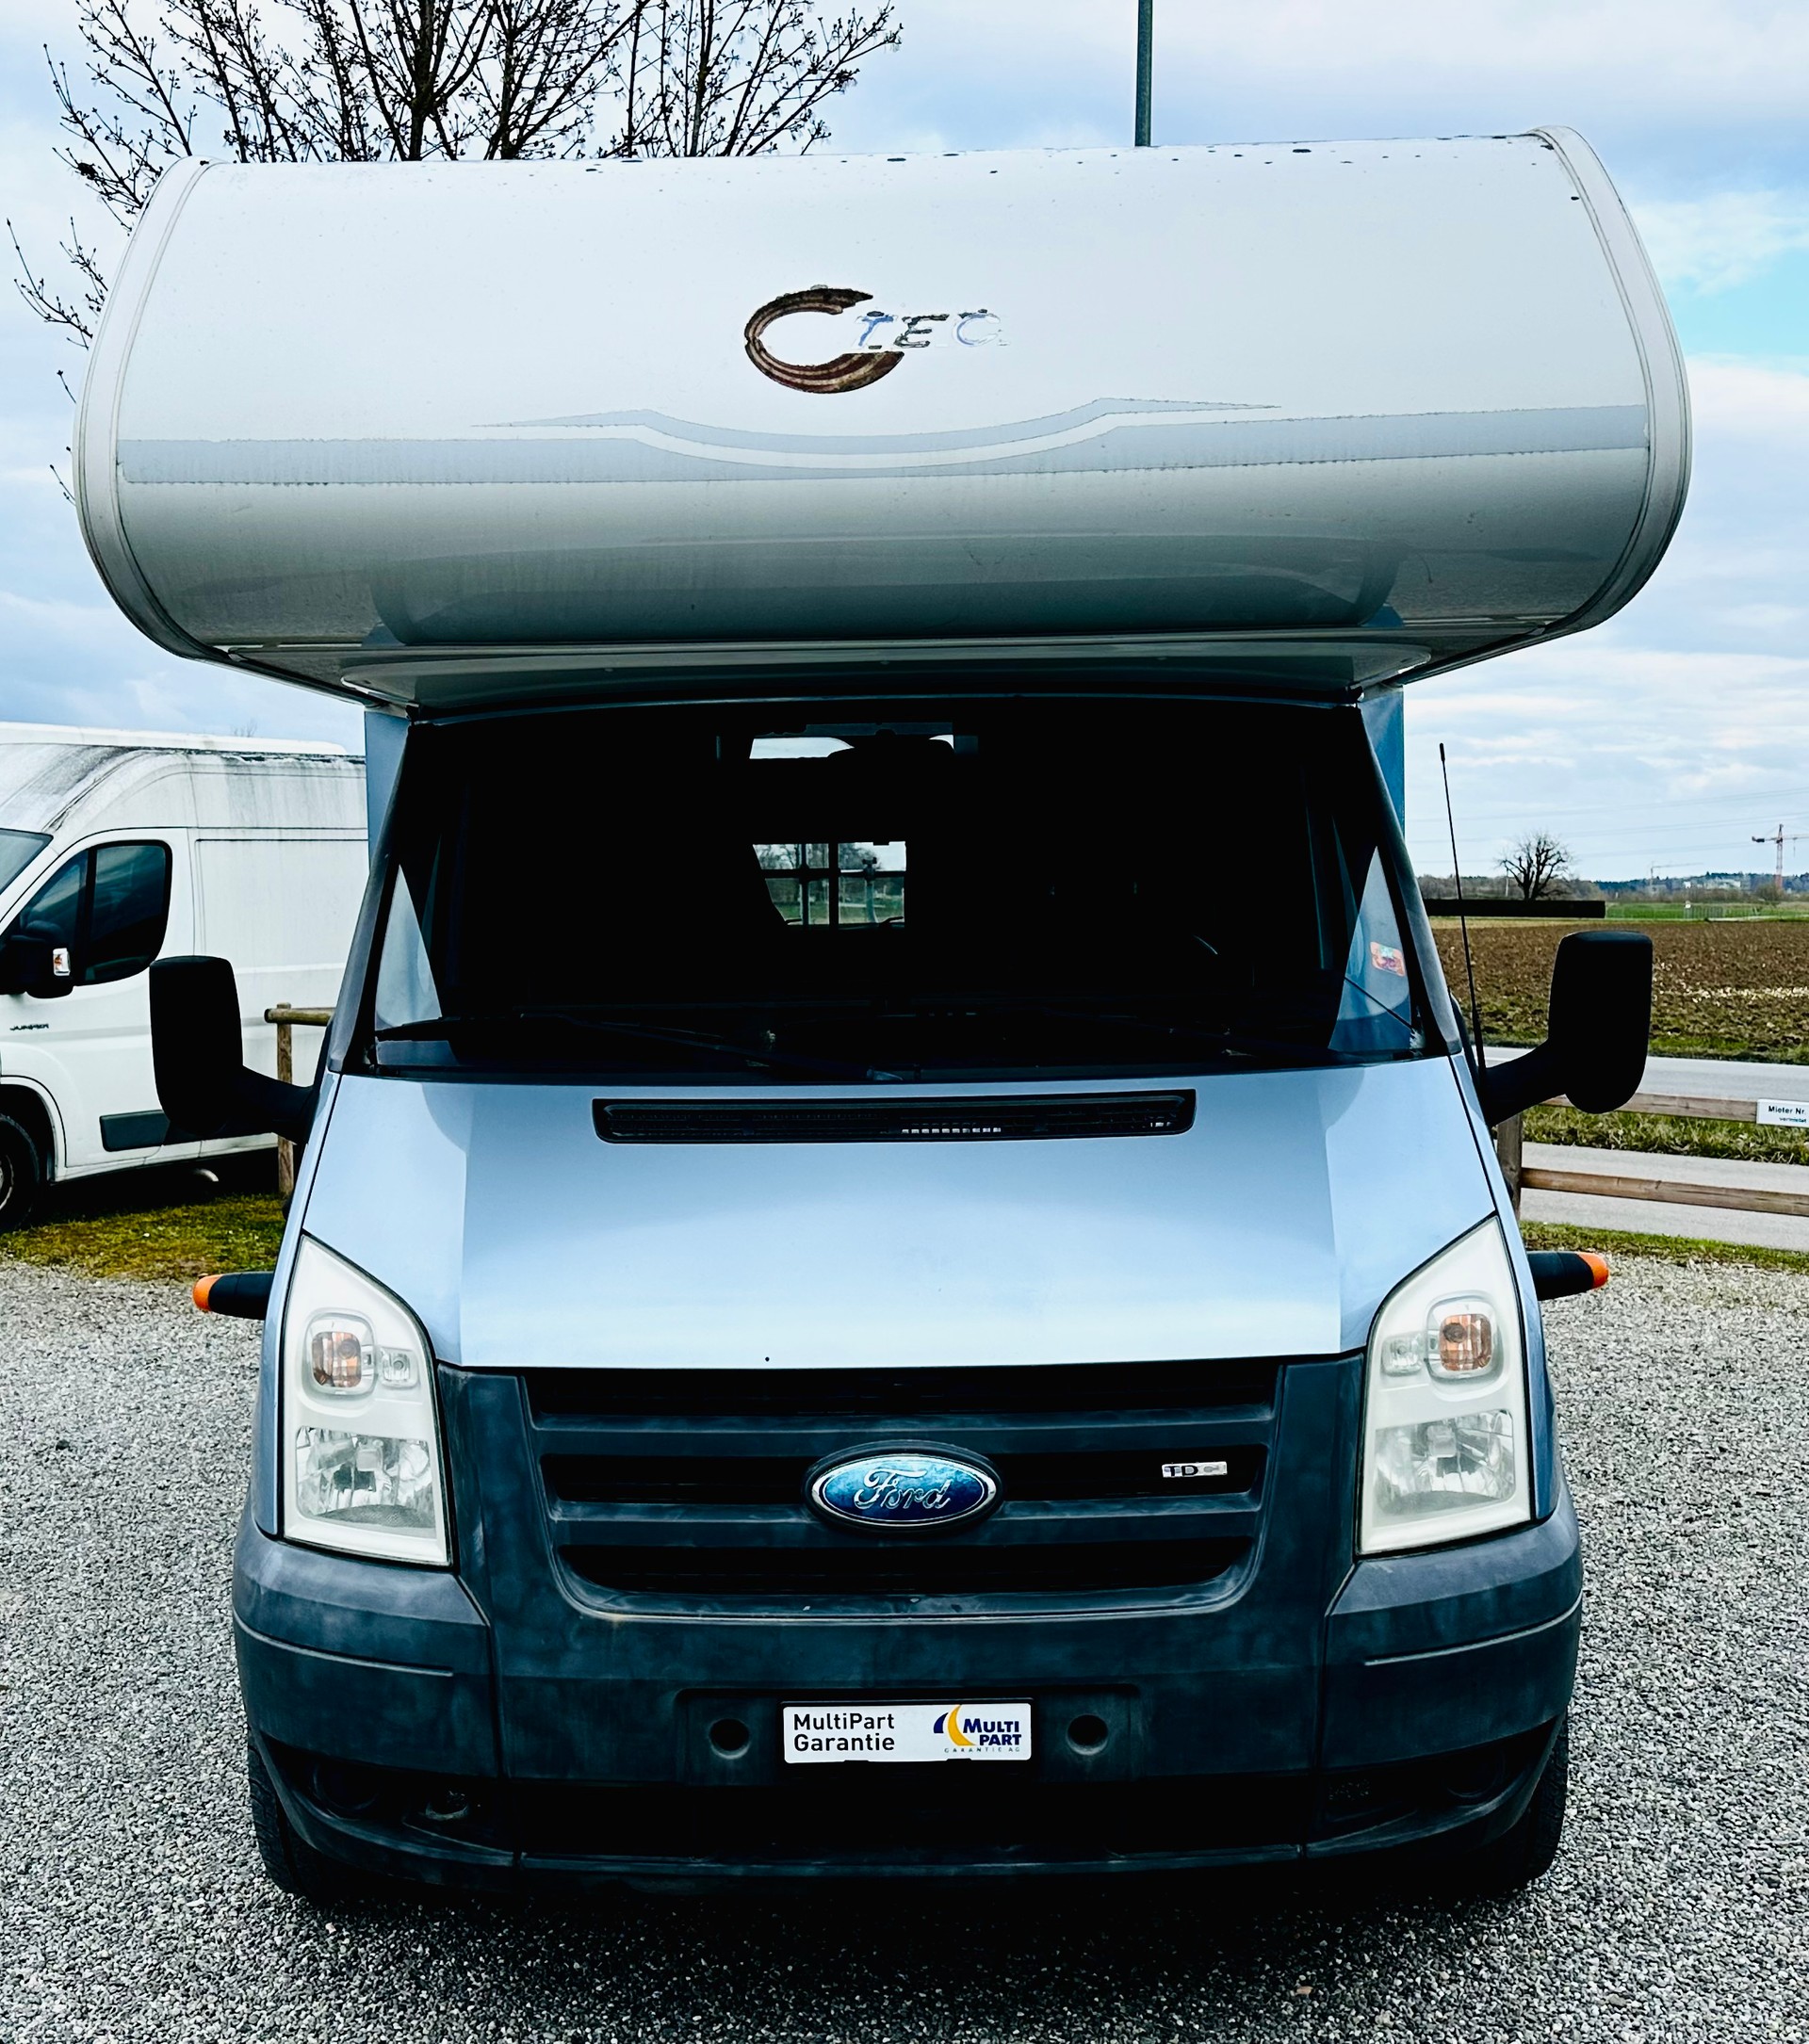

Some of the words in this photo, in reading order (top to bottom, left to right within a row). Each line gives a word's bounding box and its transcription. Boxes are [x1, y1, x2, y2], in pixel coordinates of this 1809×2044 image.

[854, 1467, 953, 1510] Ford
[793, 1712, 895, 1731] MultiPart
[793, 1733, 895, 1752] Garantie
[979, 1733, 1022, 1746] PART
